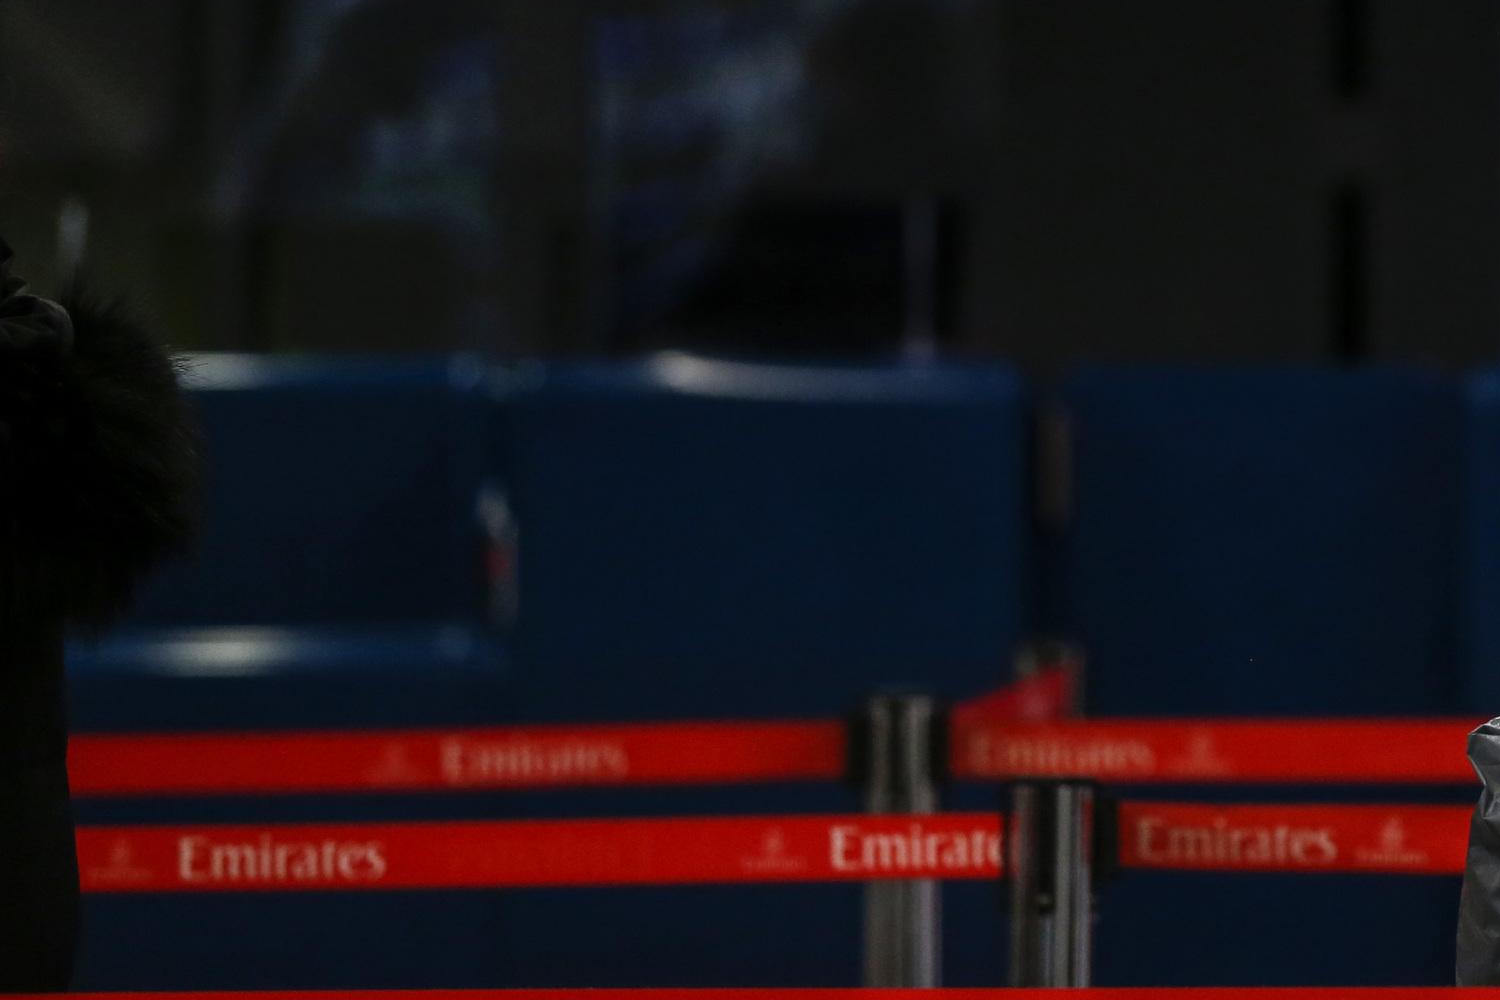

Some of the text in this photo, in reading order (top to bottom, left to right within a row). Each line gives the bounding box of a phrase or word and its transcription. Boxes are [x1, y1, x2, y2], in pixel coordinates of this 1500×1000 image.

[440, 734, 630, 786] Emirates
[968, 730, 1156, 778] Emirates
[177, 832, 387, 882] Emirates
[1136, 815, 1337, 865] Emirates
